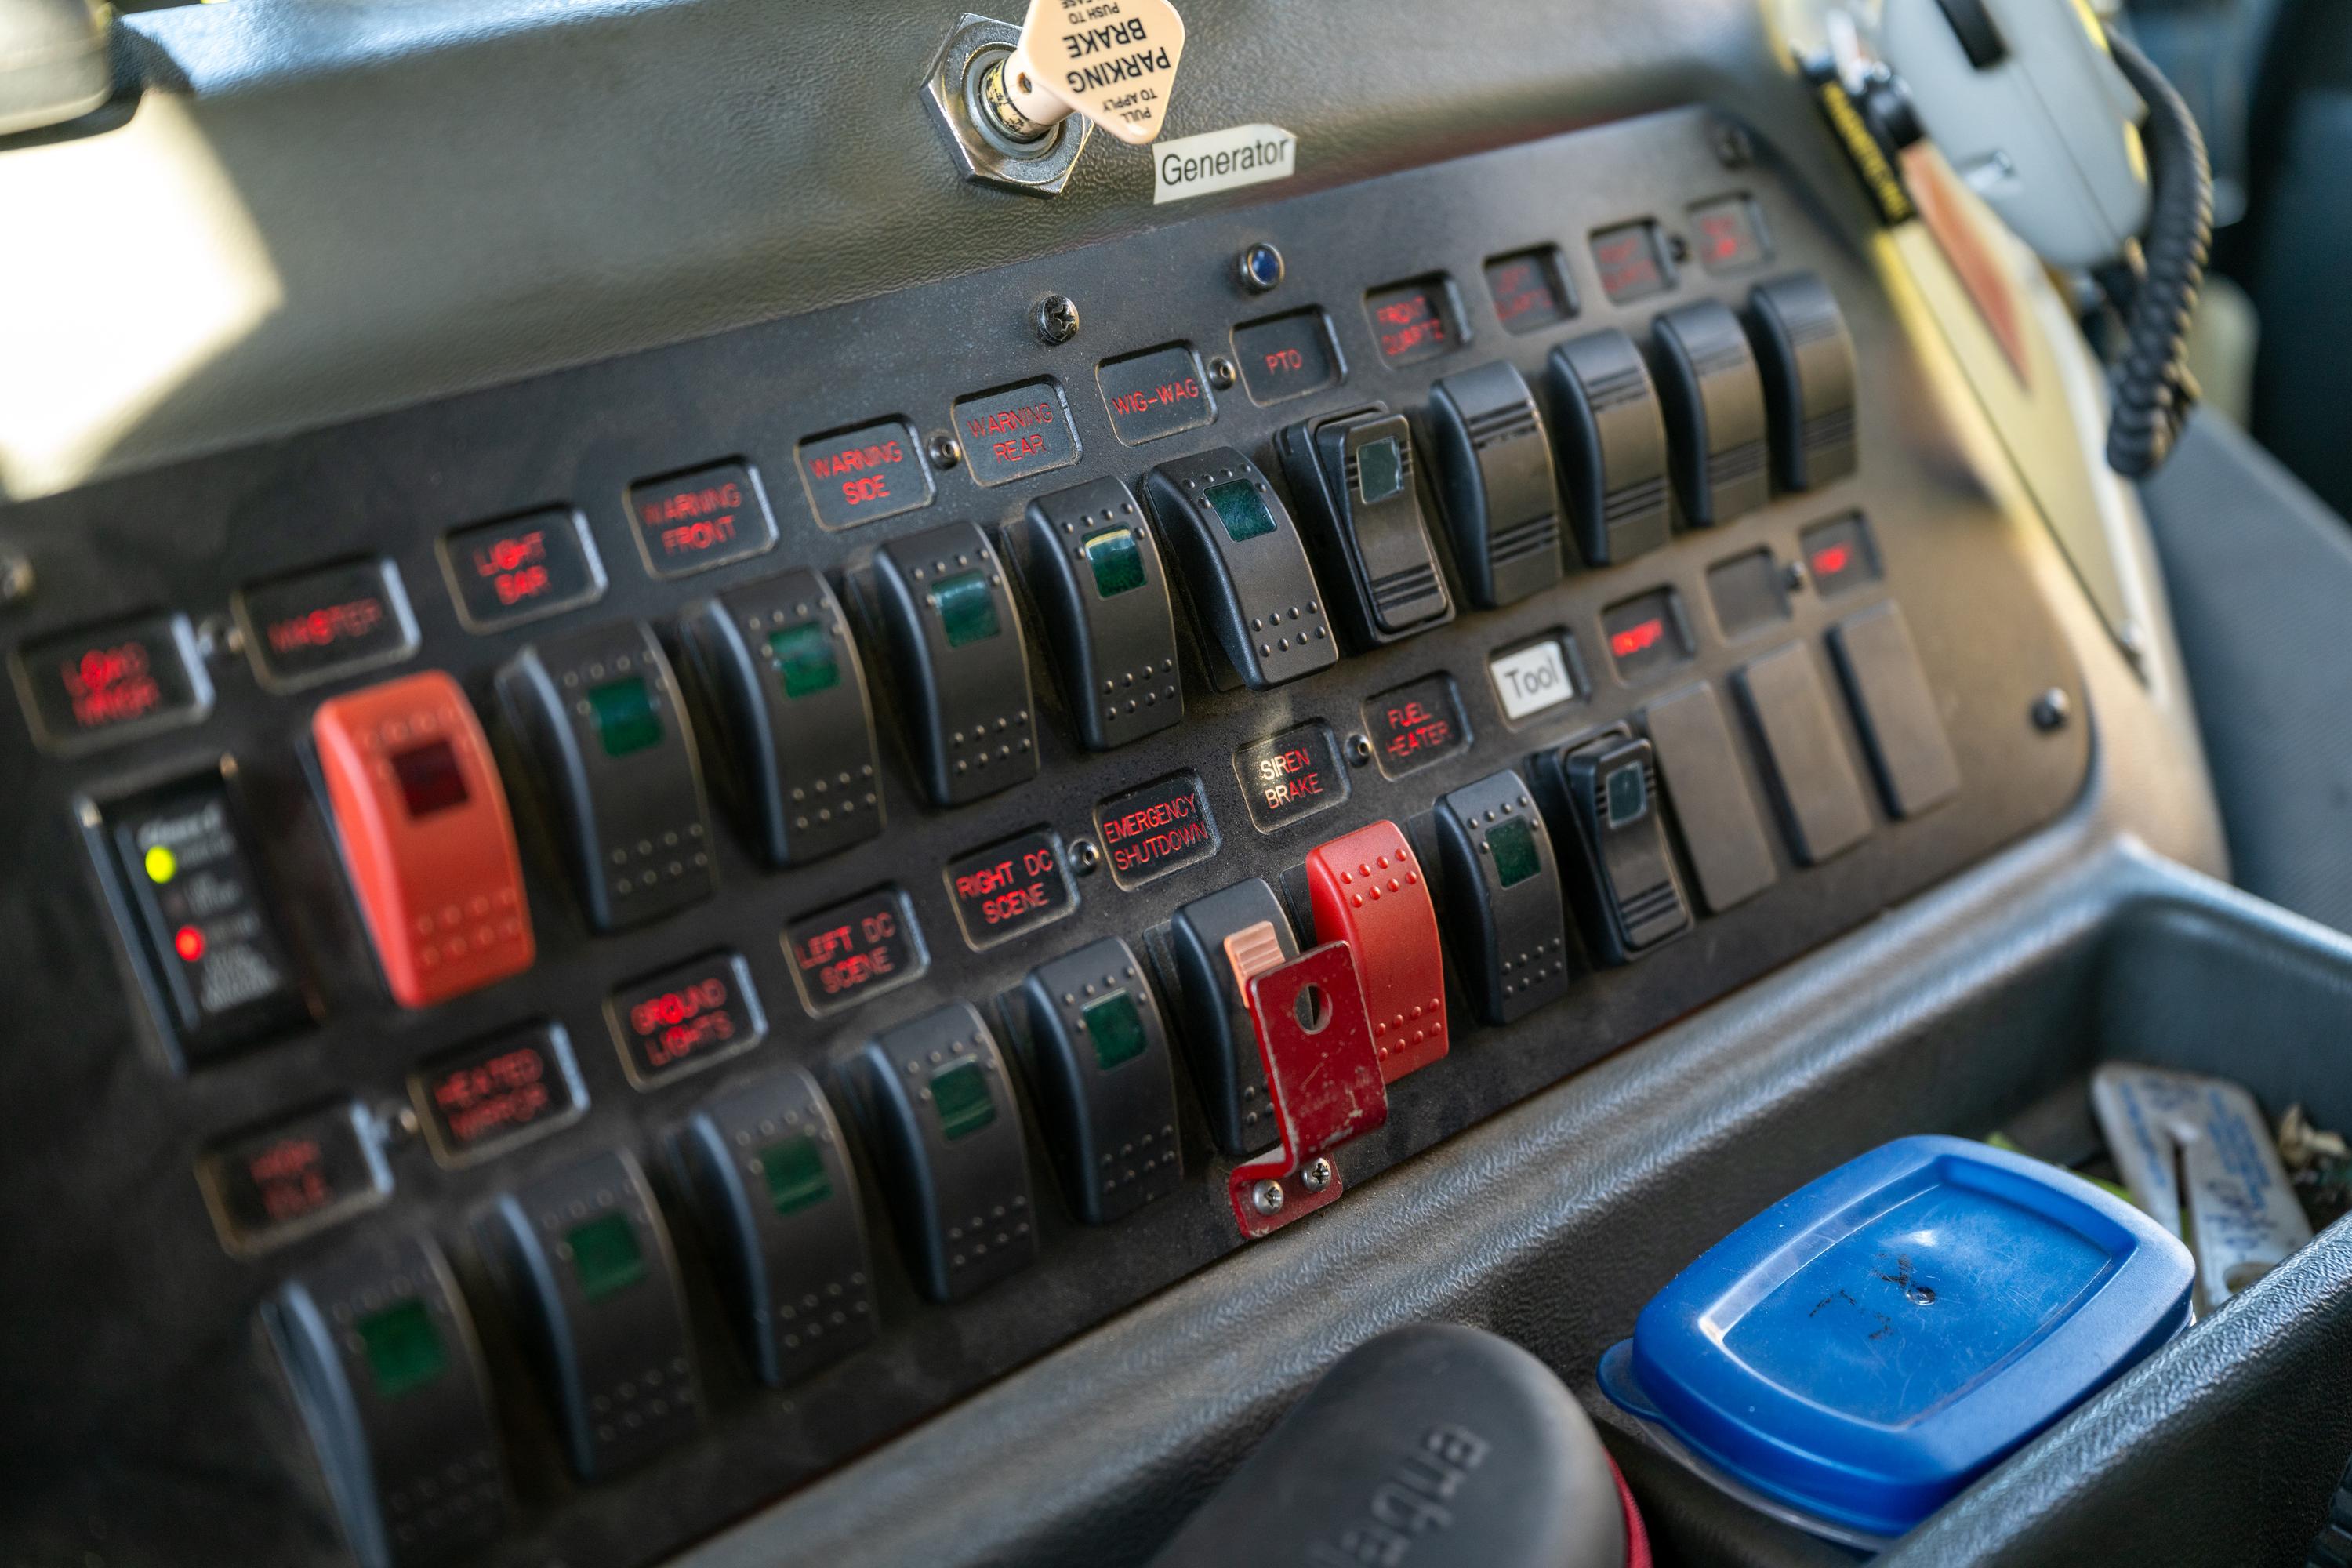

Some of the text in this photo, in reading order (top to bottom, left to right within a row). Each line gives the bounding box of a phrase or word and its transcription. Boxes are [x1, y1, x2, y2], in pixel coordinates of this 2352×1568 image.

[1069, 2, 1120, 24] PUSH TO
[1062, 17, 1147, 59] BRAKE
[1066, 46, 1171, 93] PARKING
[1102, 88, 1158, 112] TO APPLY
[1120, 107, 1152, 123] PULL
[1162, 139, 1289, 186] Generator
[1265, 348, 1303, 375] PTO
[1112, 377, 1200, 416] WIG-WAG
[967, 402, 1053, 439] WARNING
[809, 439, 903, 480] WARNING
[992, 434, 1045, 463] REAR
[641, 482, 742, 527] WARNING
[842, 474, 891, 506] SIDE
[662, 515, 736, 555] FRONT
[1504, 659, 1559, 701] Tool
[1387, 702, 1432, 730] FUEL
[1386, 720, 1454, 759] HEATER
[1260, 747, 1312, 781] SIREN
[1264, 773, 1324, 809] BRAKE
[1103, 792, 1197, 844] EMERGENCY
[1113, 821, 1209, 873] SHUTDOWN
[956, 848, 1052, 902] RIGHT DC
[982, 882, 1051, 925] SCENE
[796, 911, 896, 971] LEFT DC
[819, 946, 895, 996] SCENE
